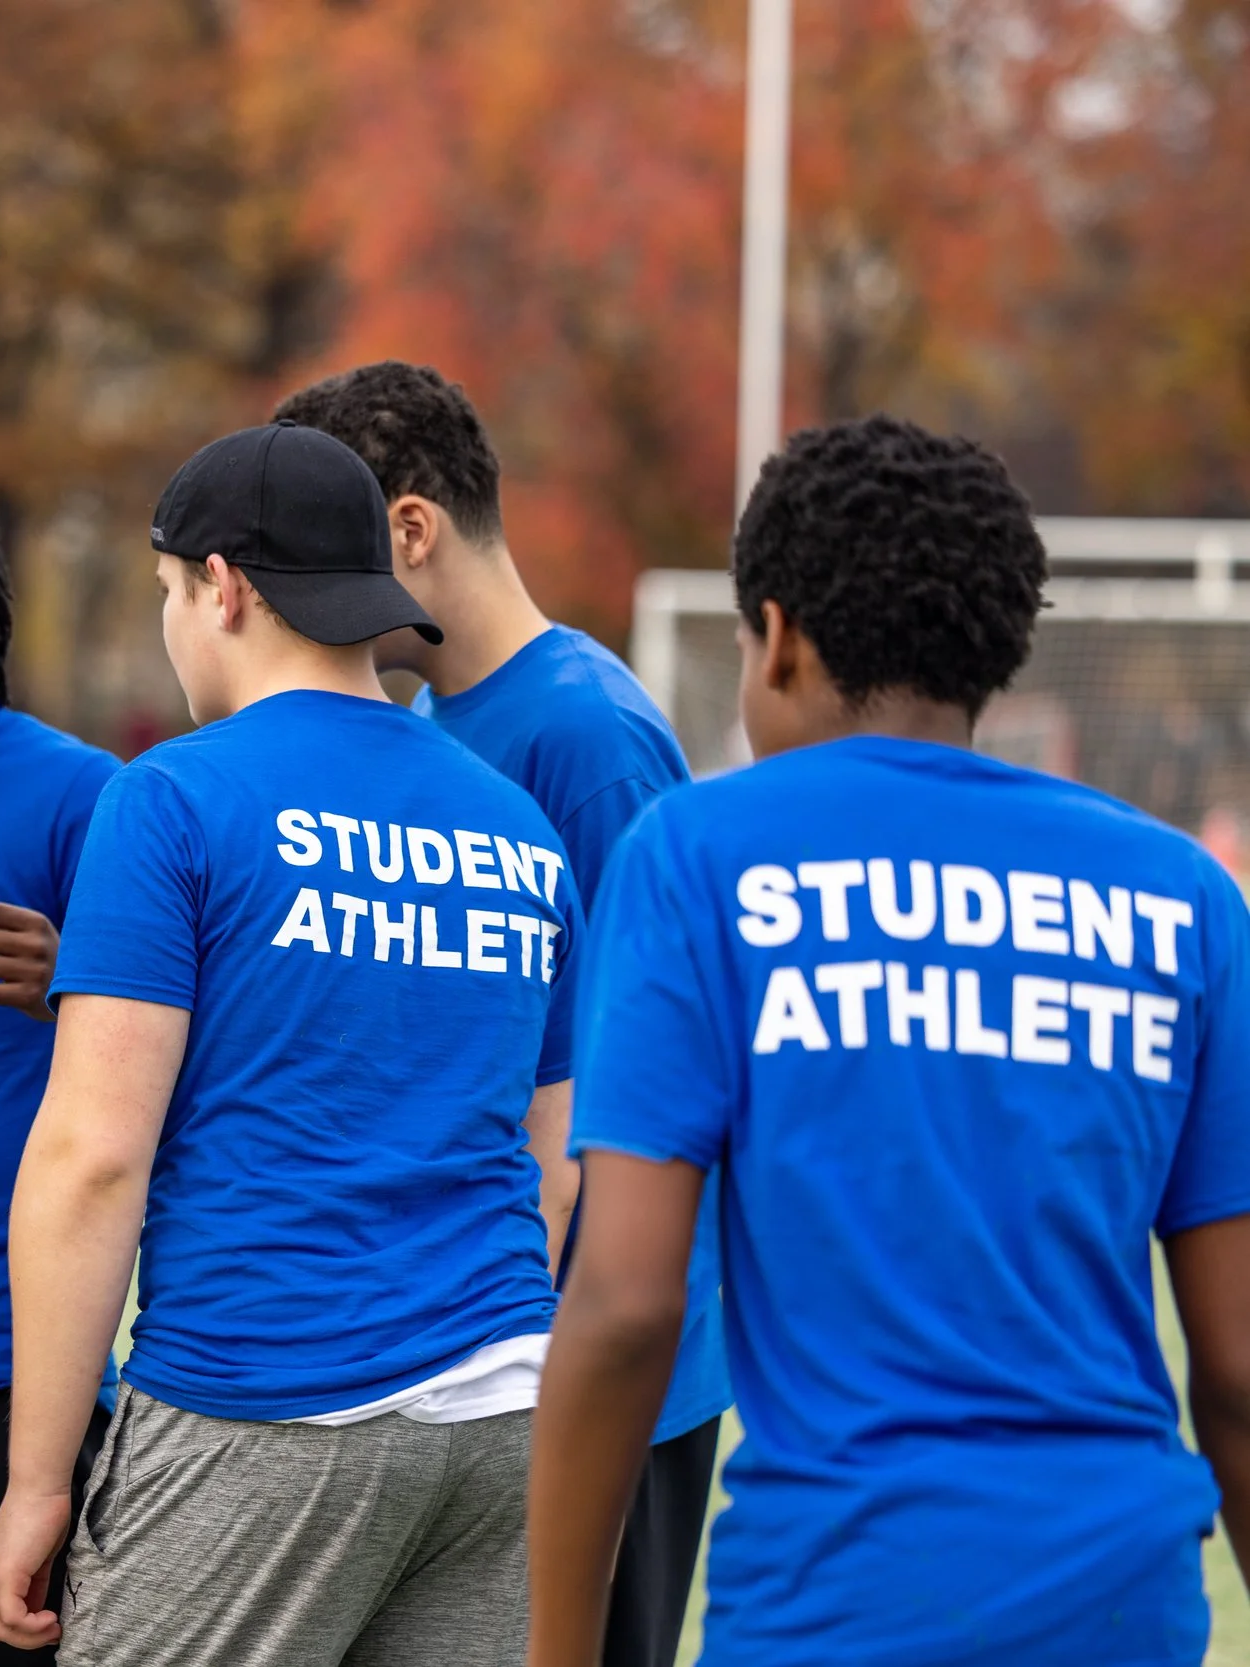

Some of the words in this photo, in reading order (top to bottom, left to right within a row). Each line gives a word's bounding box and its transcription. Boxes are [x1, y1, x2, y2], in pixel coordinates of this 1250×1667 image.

[276, 808, 565, 907] STUDENT
[270, 887, 562, 985] ATHLETE
[736, 857, 1194, 976] STUDENT
[752, 959, 1180, 1083] ATHLETE
